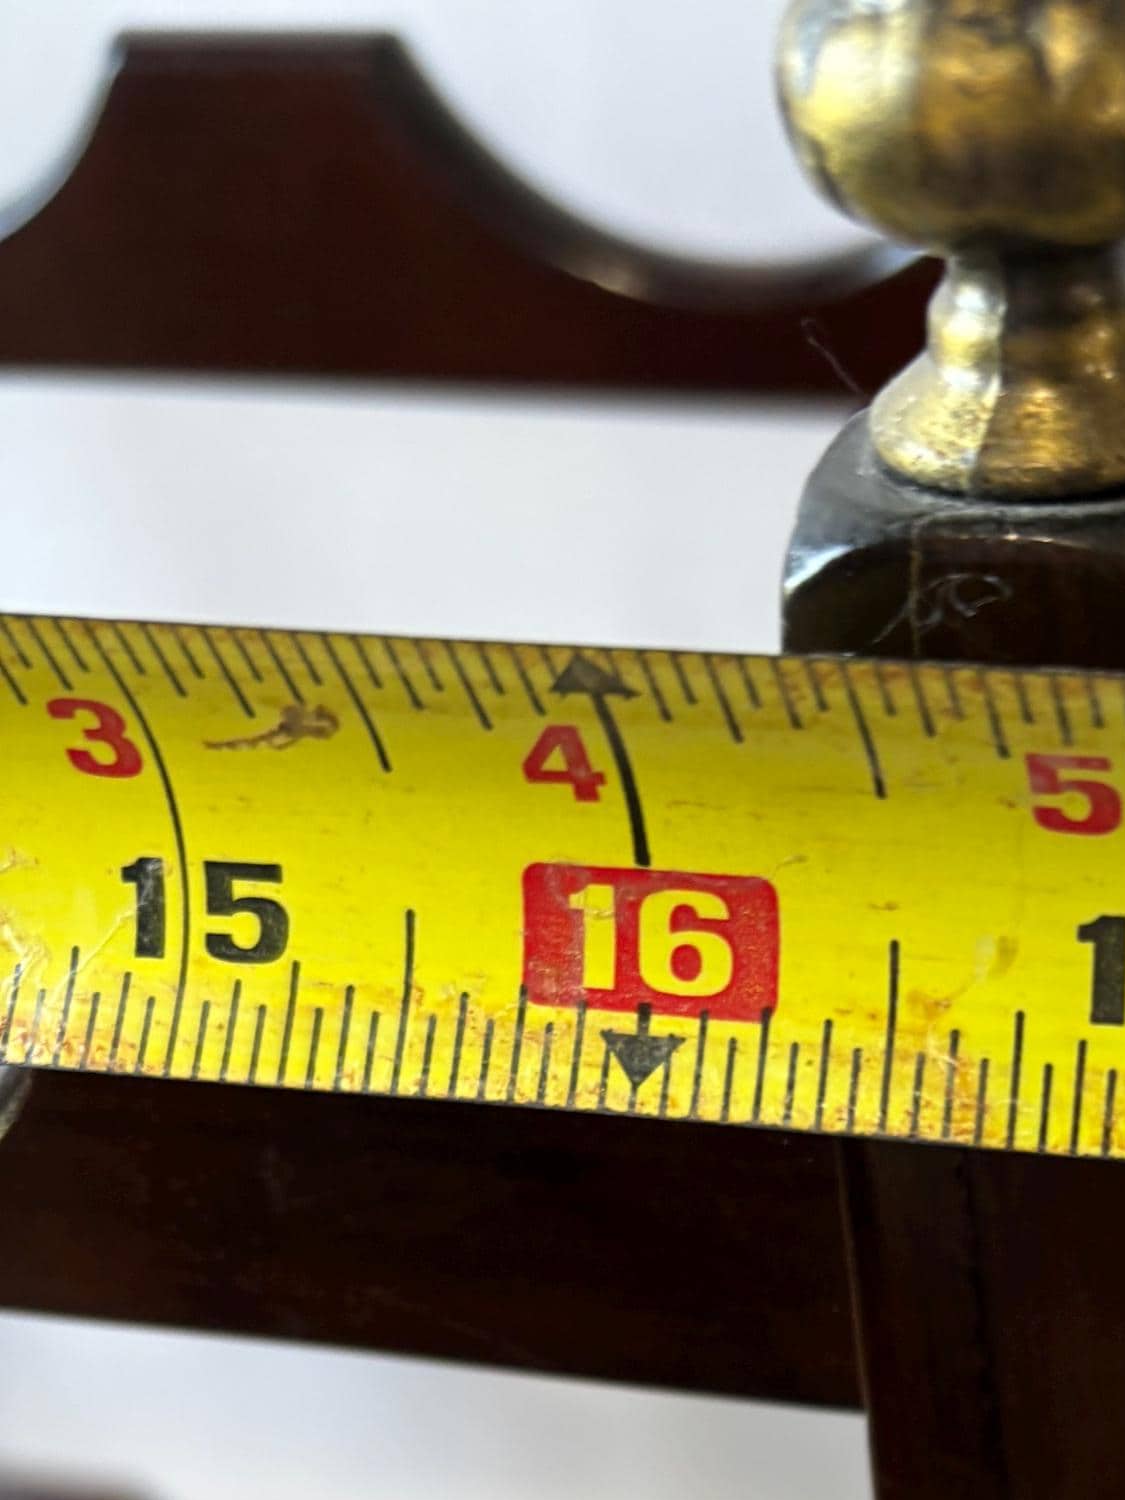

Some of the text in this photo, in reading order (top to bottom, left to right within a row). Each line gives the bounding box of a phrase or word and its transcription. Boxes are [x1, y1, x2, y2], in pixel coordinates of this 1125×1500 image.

[46, 697, 143, 778] 3
[522, 724, 607, 802] 4
[1025, 753, 1123, 835] 5
[121, 857, 290, 964] 15
[568, 884, 735, 998] 16
